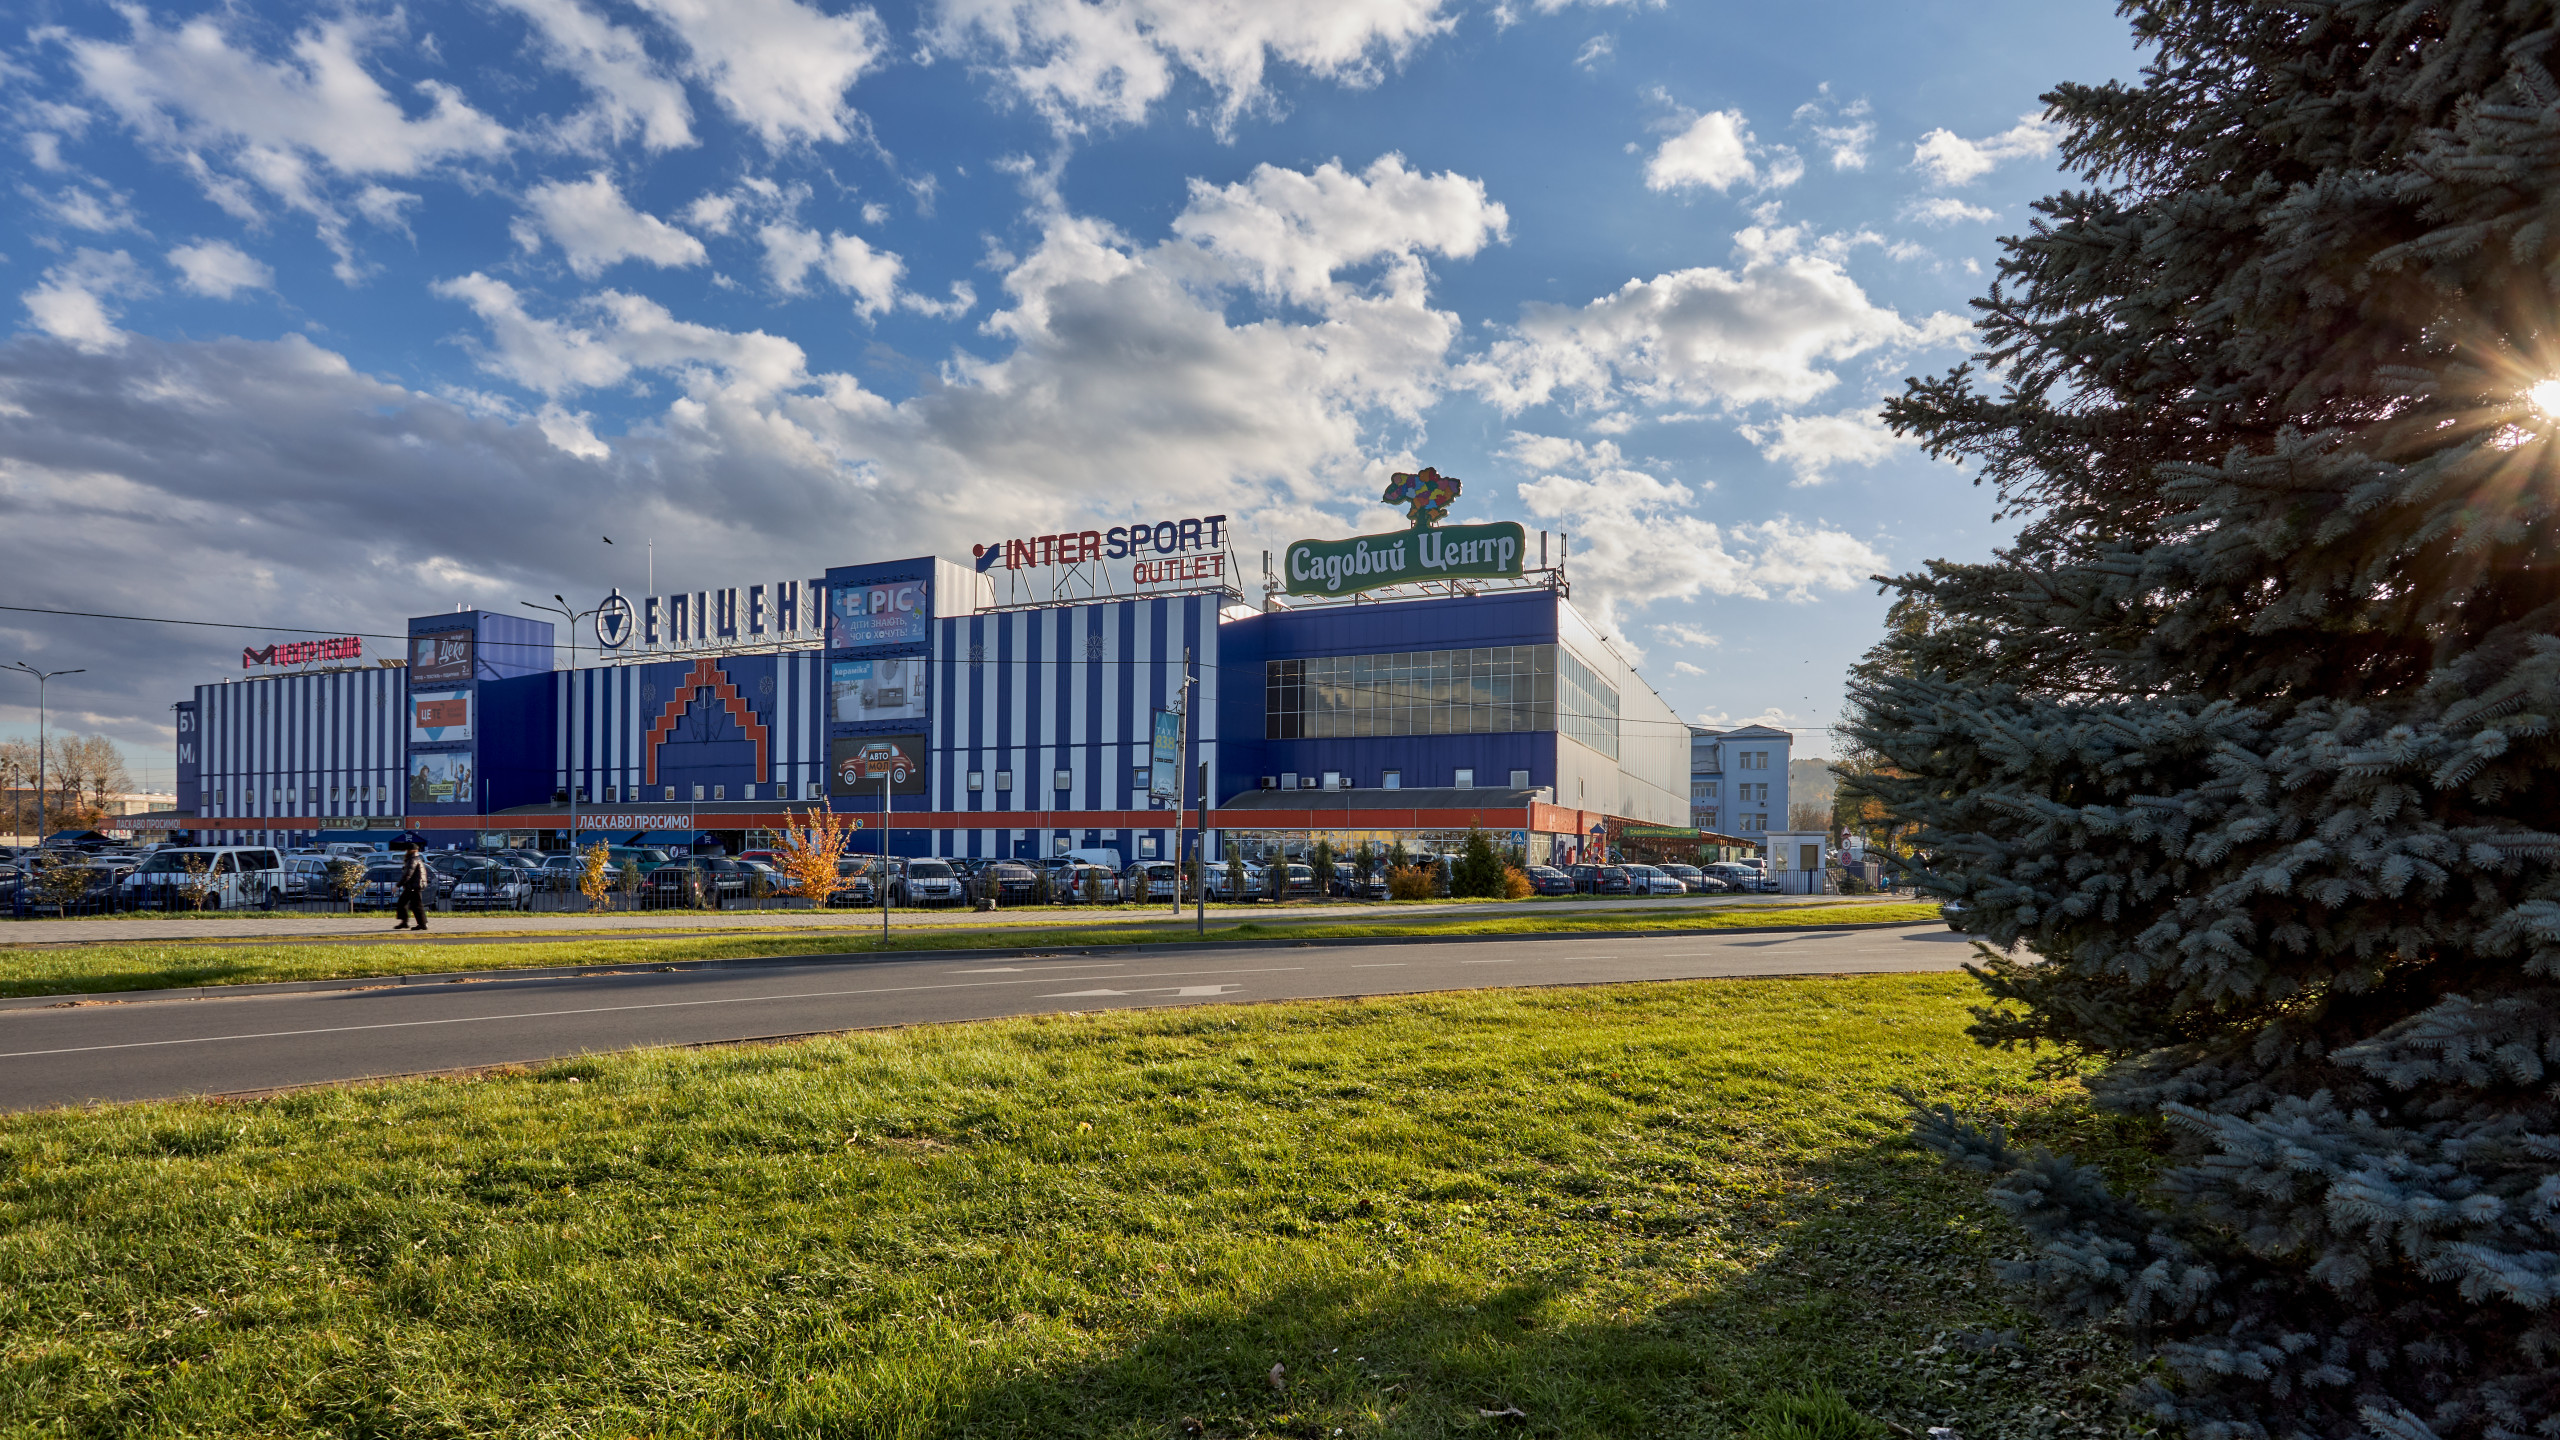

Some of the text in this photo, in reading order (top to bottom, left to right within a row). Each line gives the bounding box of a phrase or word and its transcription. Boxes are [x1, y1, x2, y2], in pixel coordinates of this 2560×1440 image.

[1006, 515, 1226, 570] INTERSPORT
[1292, 531, 1515, 591] Садовий Центр
[1133, 555, 1224, 584] OUTLET
[846, 587, 913, 617] E.PIC
[850, 620, 869, 631] ДІТИ
[850, 628, 908, 640] ЧОГО ХОЧУТЬ!
[1157, 726, 1176, 736] TAXI
[1155, 735, 1175, 750] 838
[869, 752, 889, 761] АВТО
[868, 761, 889, 771] МОЛ
[116, 819, 181, 829] ЛАСКАВО ПРОСИМО!
[579, 815, 632, 829] ЛАСКАВО
